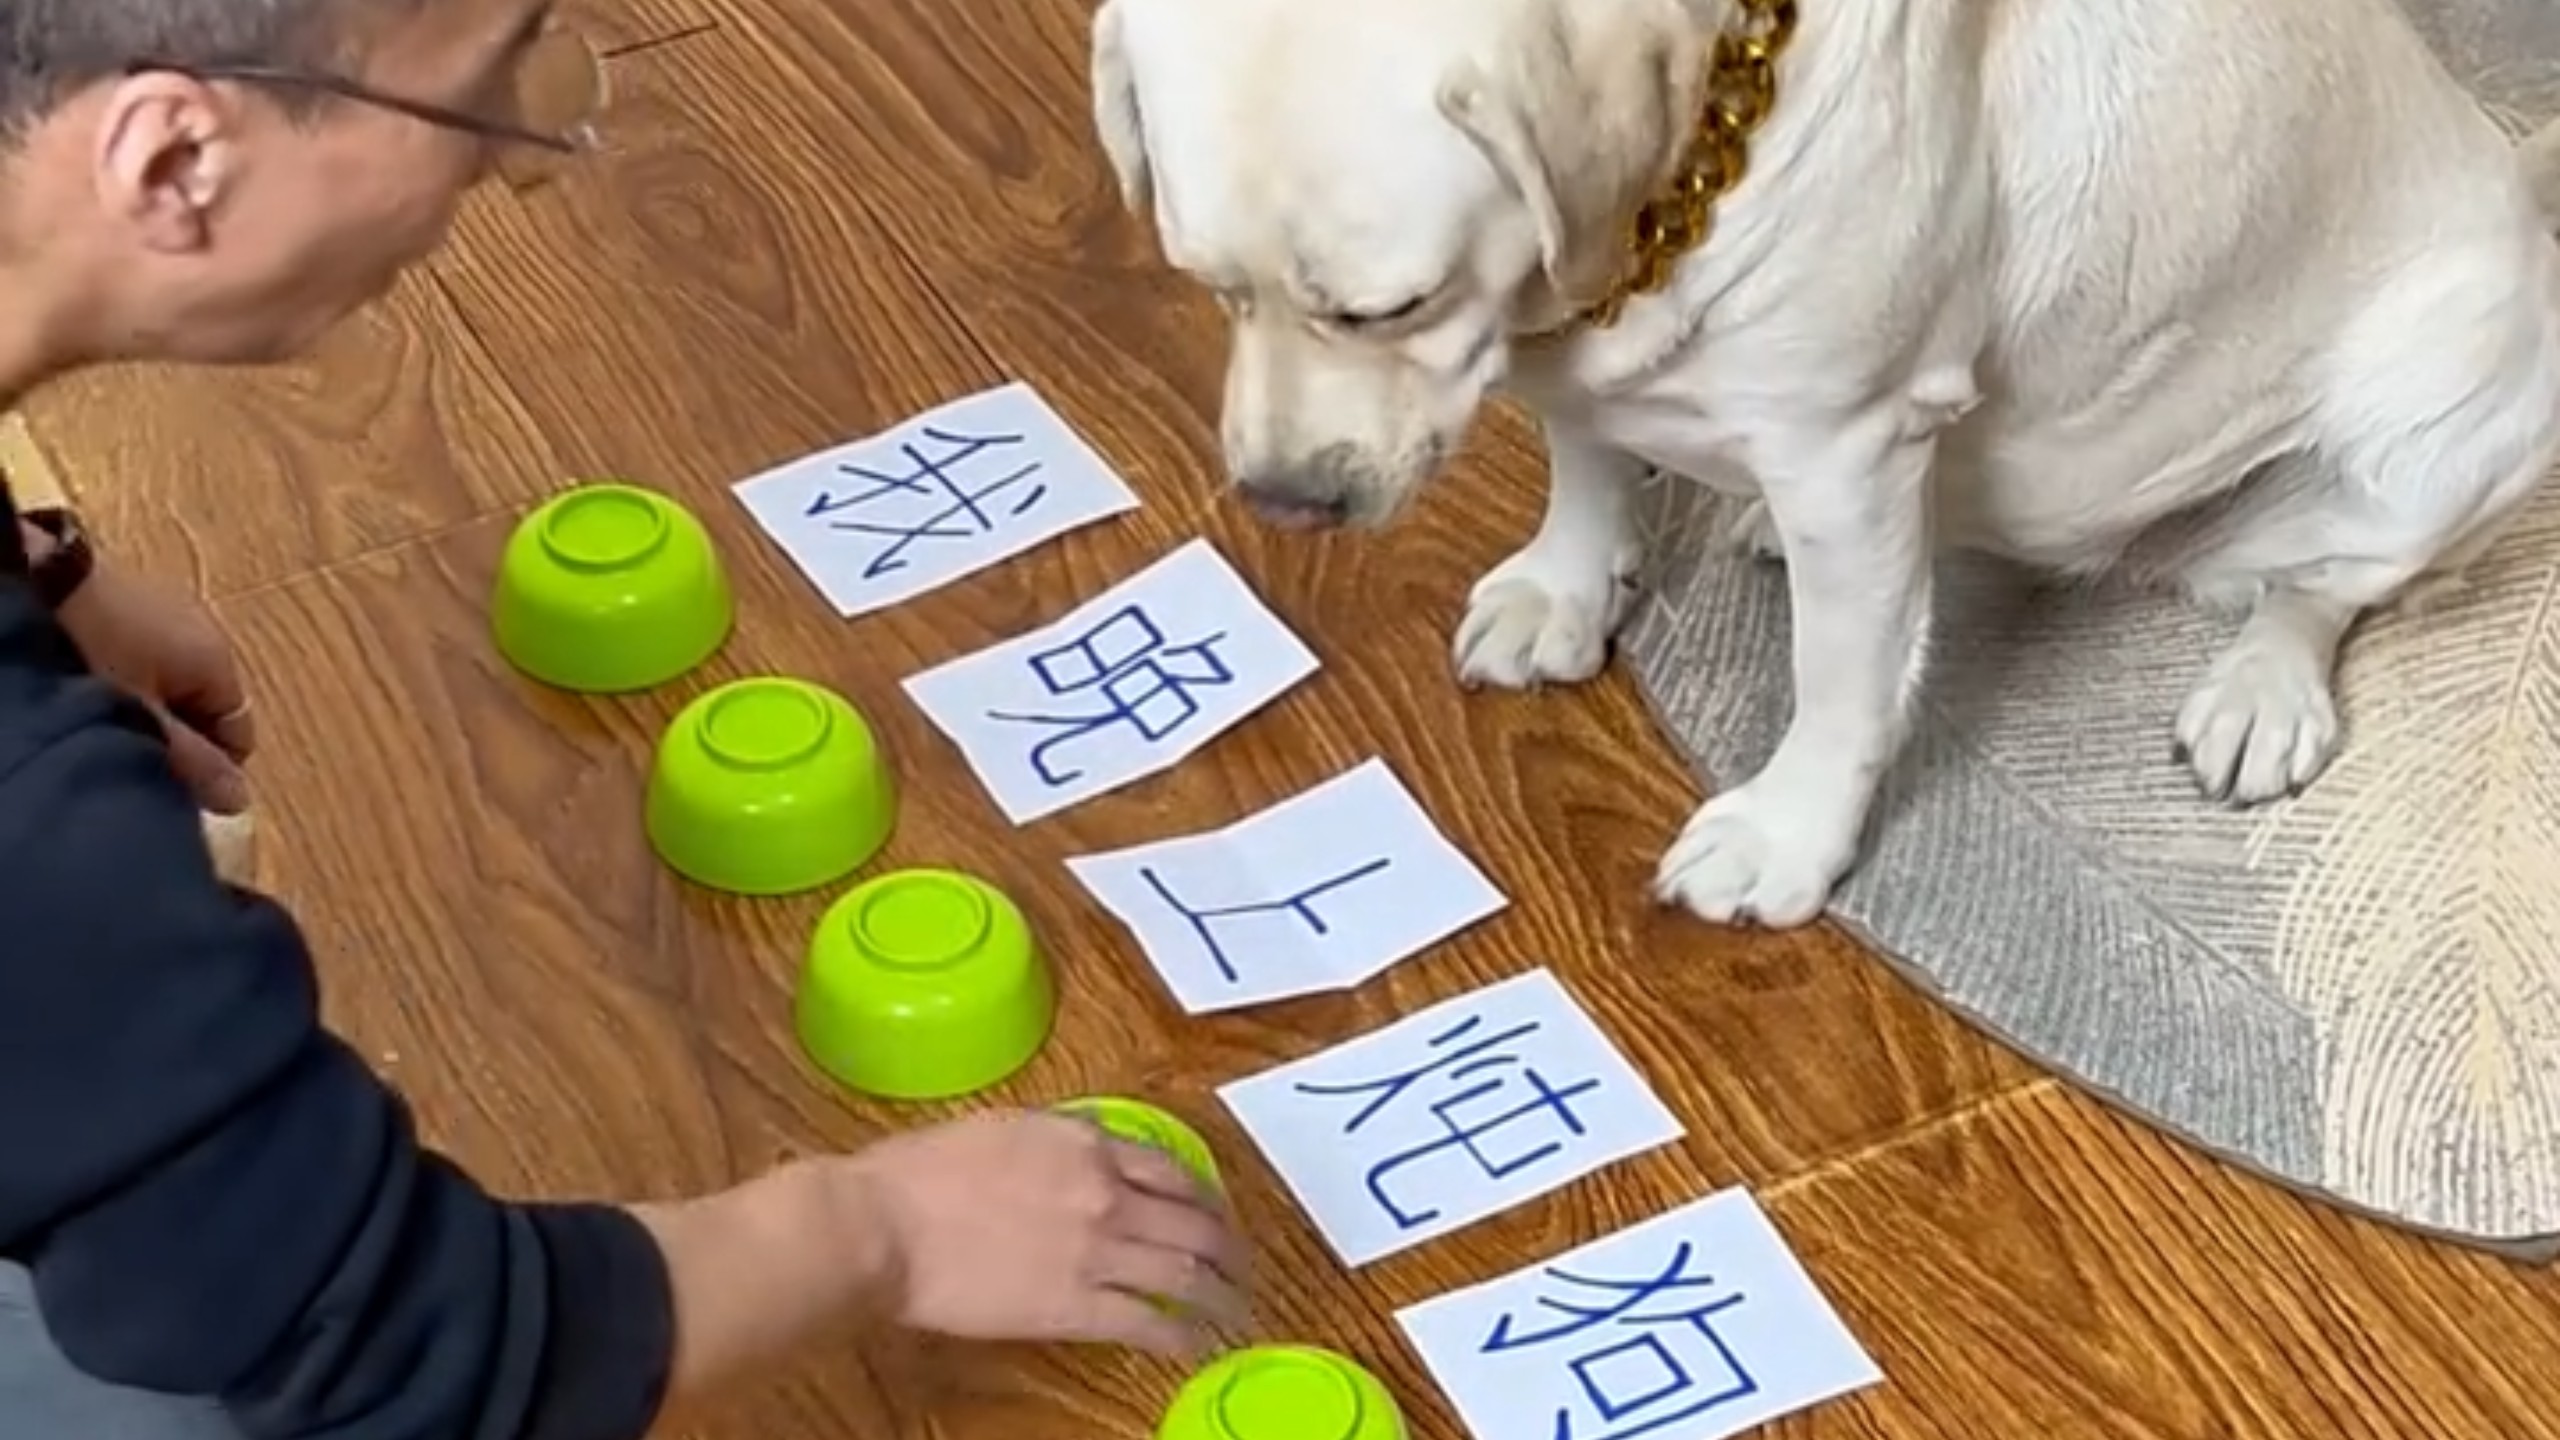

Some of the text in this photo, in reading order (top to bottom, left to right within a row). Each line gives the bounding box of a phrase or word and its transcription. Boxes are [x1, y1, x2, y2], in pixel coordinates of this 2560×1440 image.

[805, 426, 1047, 578] 我
[986, 603, 1234, 785] 晚
[1141, 858, 1391, 983] 上
[1294, 1015, 1600, 1229] 炖
[1480, 1242, 1758, 1440] 狗
